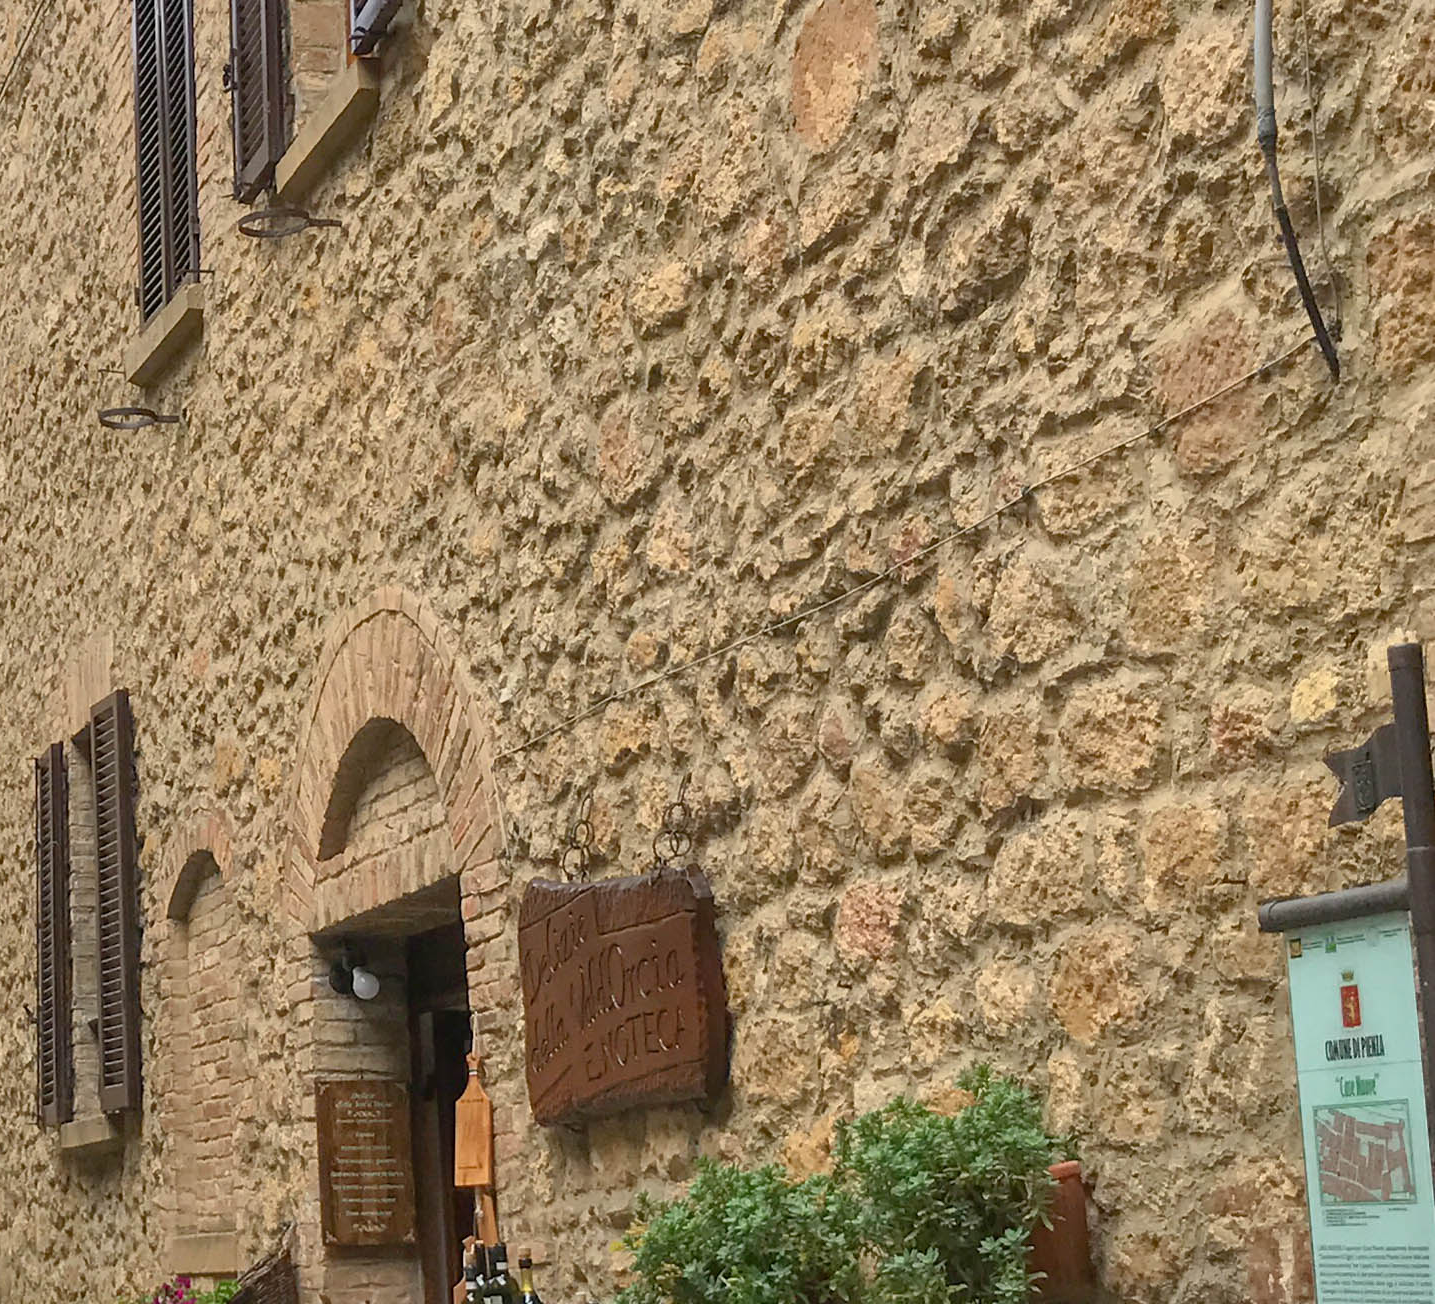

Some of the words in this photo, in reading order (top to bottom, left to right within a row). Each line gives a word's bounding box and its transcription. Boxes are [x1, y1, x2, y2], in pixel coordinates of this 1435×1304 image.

[584, 1006, 686, 1082] ENOTECA
[1325, 1038, 1352, 1062] COMUNE
[1352, 1036, 1361, 1058] DI
[1361, 1034, 1385, 1057] PIENZA
